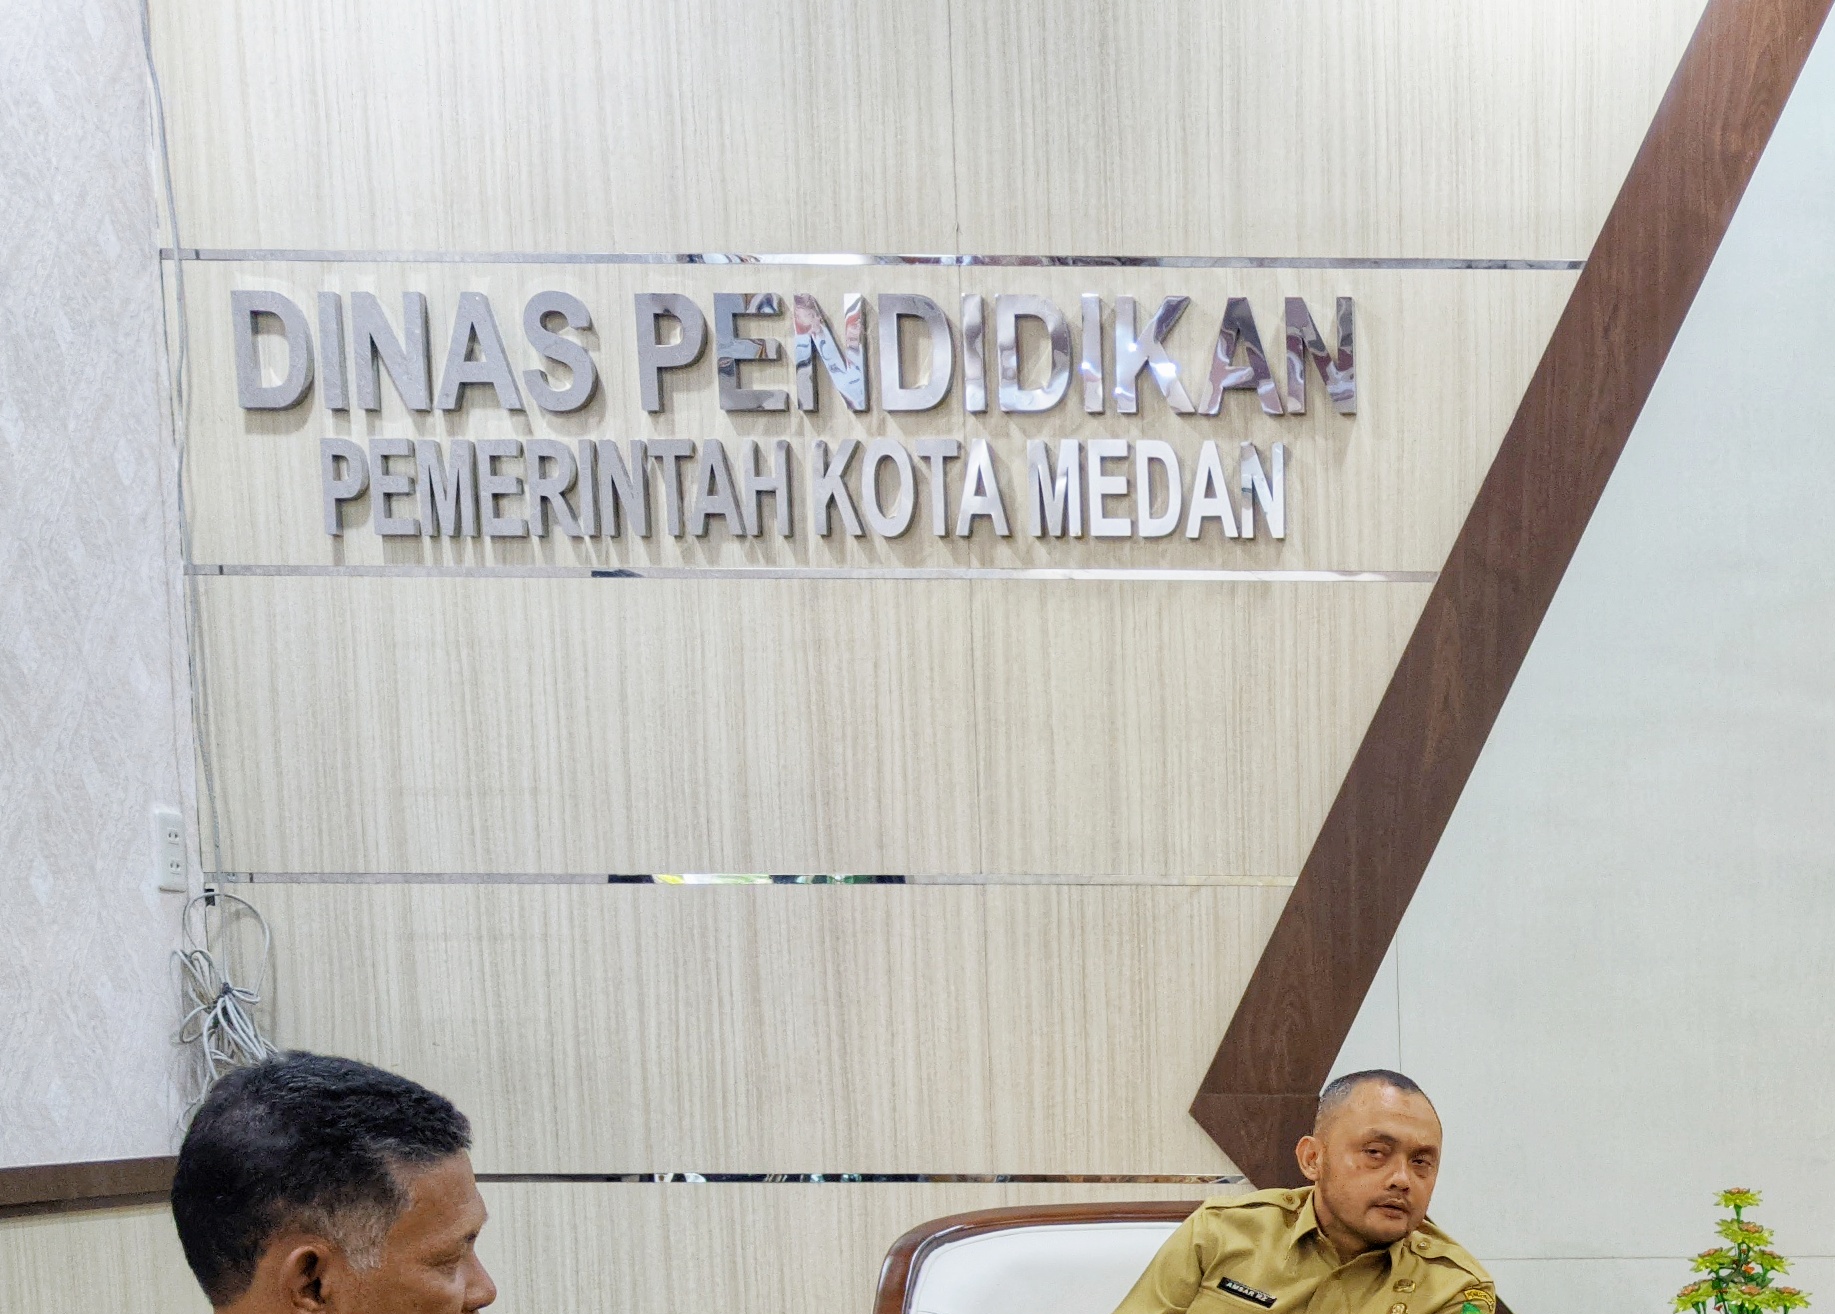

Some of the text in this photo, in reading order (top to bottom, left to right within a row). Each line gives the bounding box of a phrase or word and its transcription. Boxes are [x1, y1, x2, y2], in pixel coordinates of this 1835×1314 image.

[230, 290, 1357, 416] DINAS PENDIDIKAN
[320, 437, 1286, 540] PEMERINTAH KOTA MEDAN
